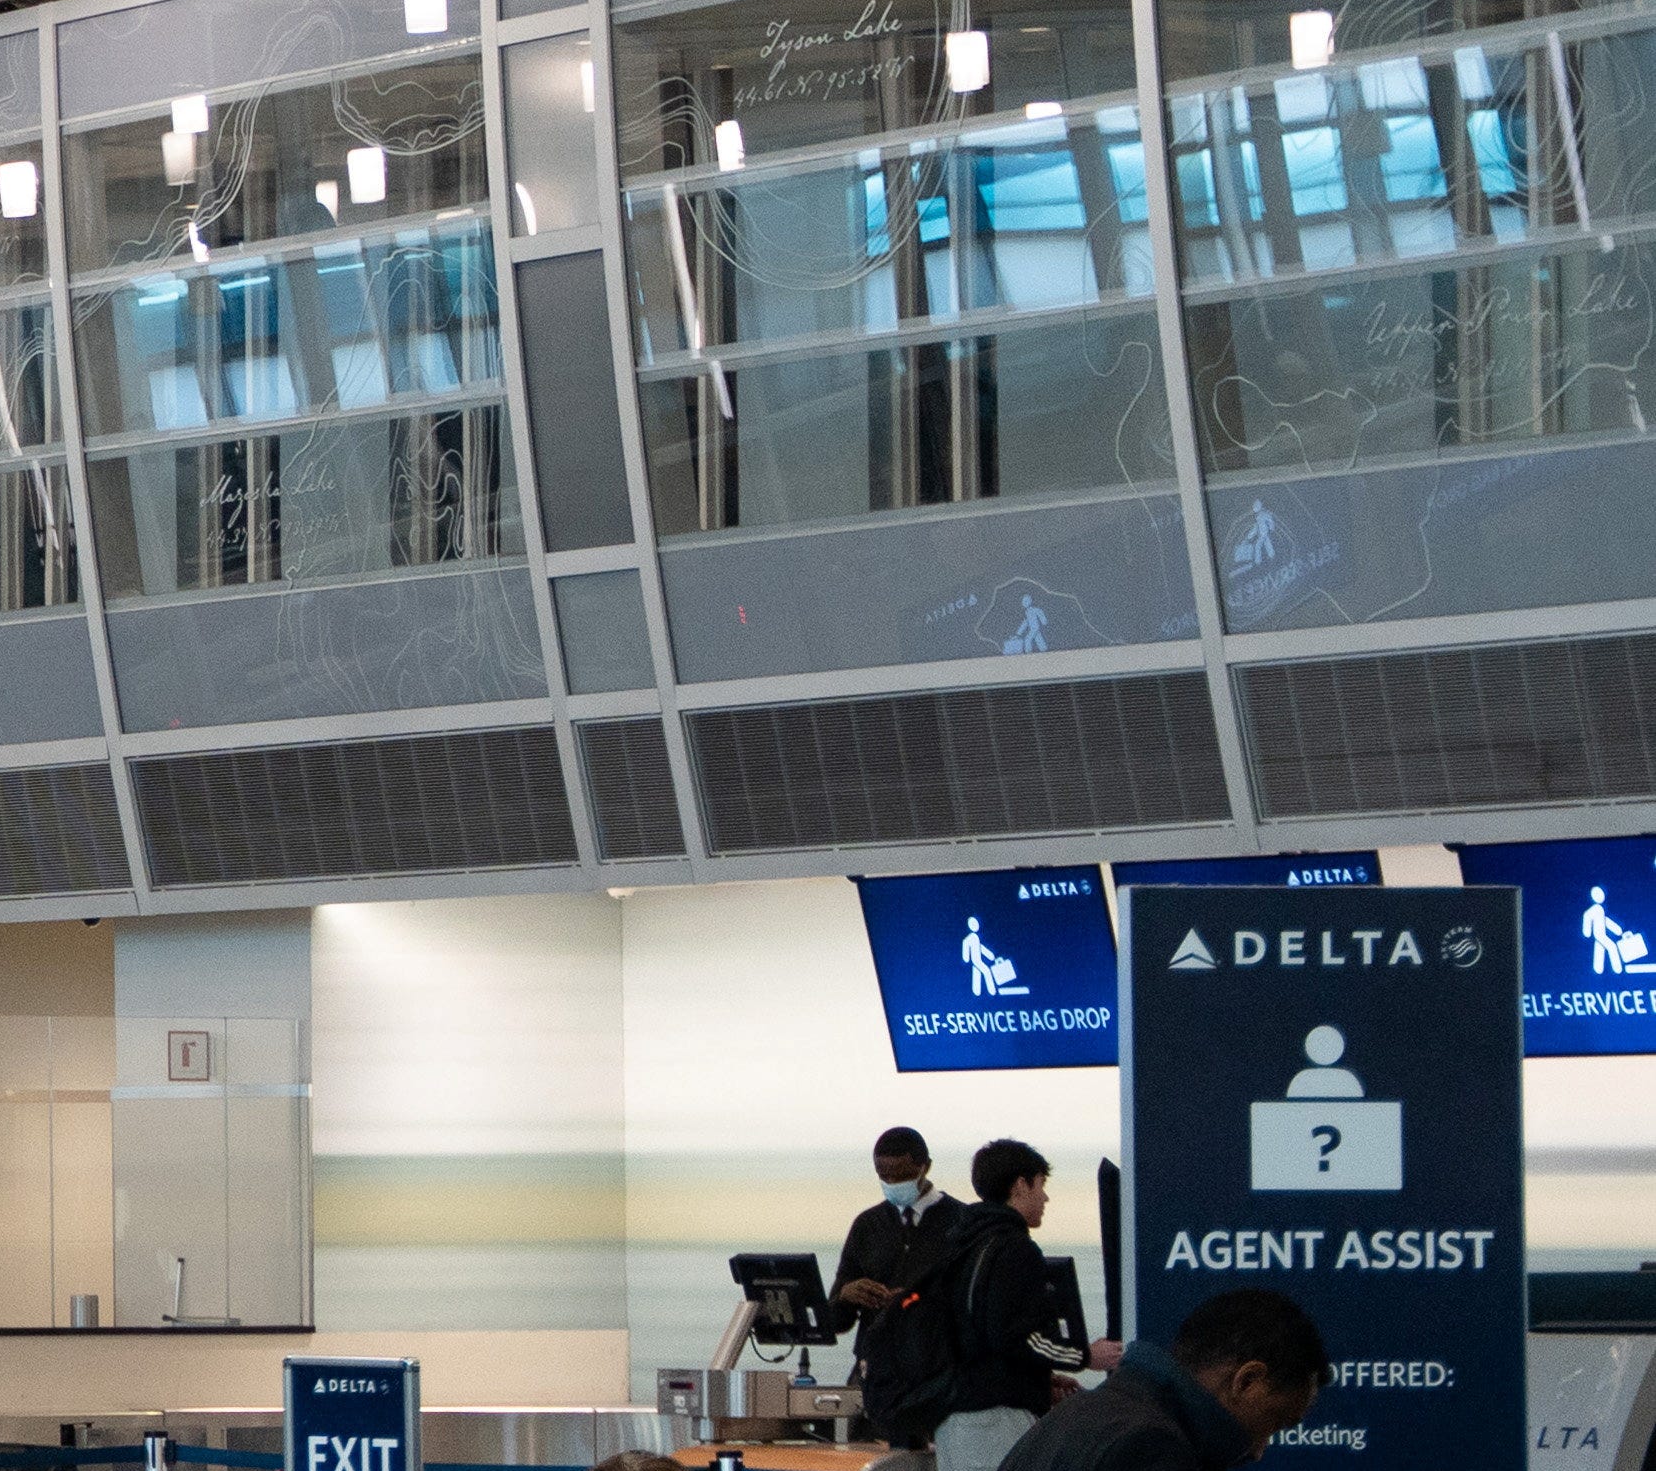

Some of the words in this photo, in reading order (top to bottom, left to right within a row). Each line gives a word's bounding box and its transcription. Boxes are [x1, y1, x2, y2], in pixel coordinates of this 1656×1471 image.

[760, 19, 834, 82] Tyson
[1302, 868, 1352, 883] DELTA
[1031, 881, 1079, 900] DELTA
[1234, 931, 1423, 966] DELTA
[1522, 990, 1647, 1019] ELF-SERVICE
[905, 1014, 1017, 1037] SELF-SERVICE
[1021, 1010, 1058, 1033] BAG
[1062, 1007, 1111, 1032] DROP
[1166, 1231, 1323, 1270] AGENT
[1337, 1231, 1495, 1270] ASSIST
[329, 1380, 376, 1394] DELTA
[1536, 1426, 1600, 1449] LTA
